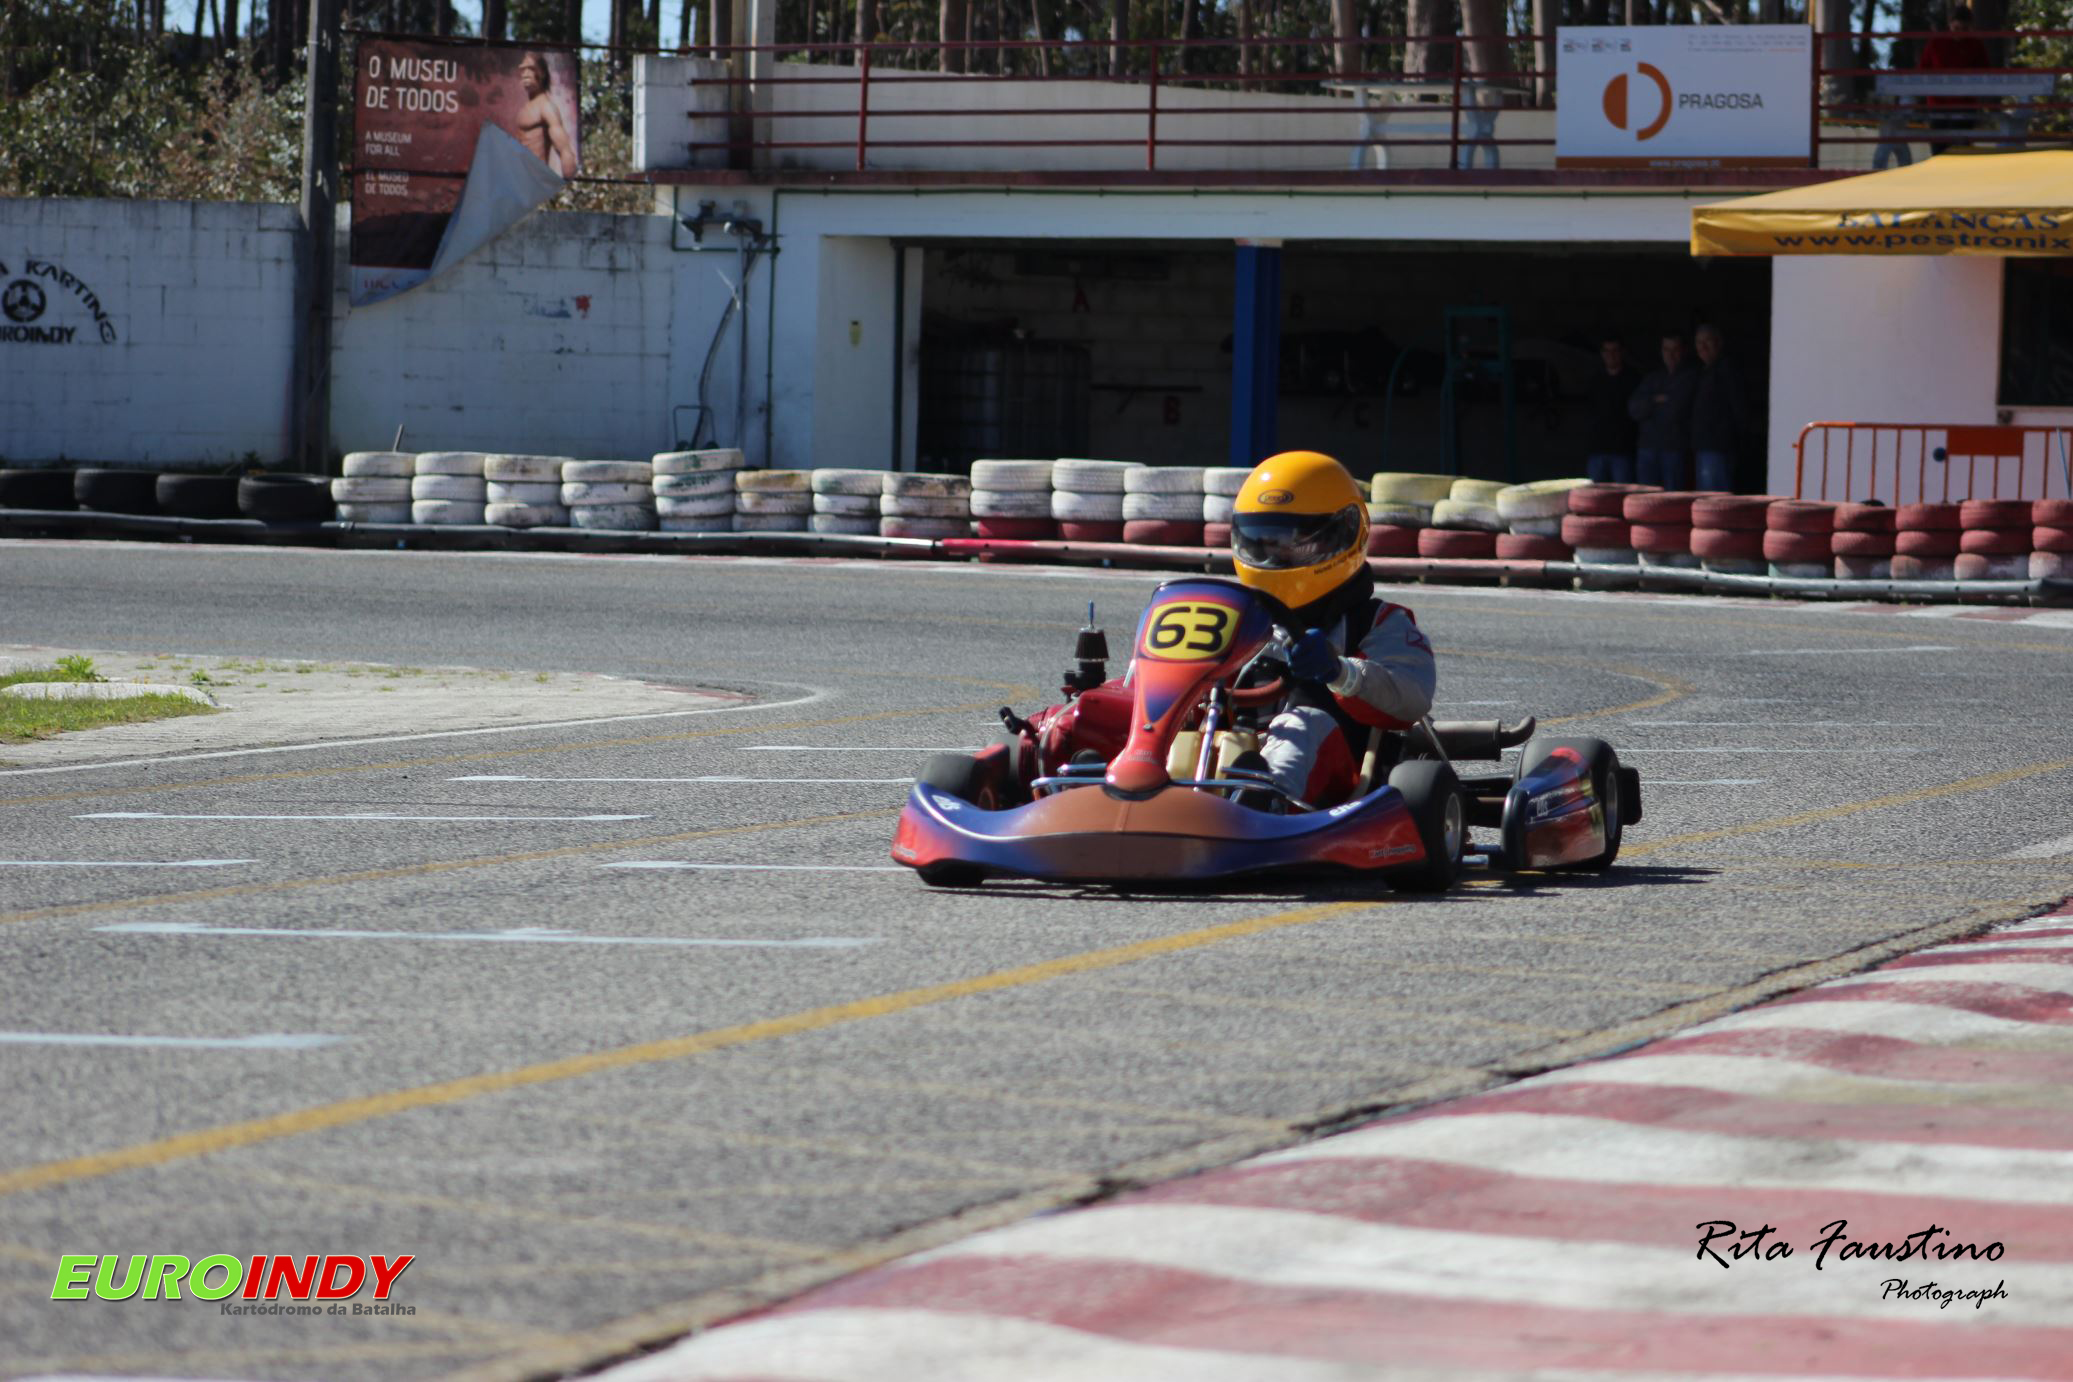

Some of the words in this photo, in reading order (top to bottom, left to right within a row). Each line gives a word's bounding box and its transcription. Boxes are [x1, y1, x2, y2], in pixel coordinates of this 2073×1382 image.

[369, 55, 381, 78] O
[390, 57, 458, 83] MUSEU
[365, 86, 389, 109] DE
[395, 87, 460, 113] TODOS
[1678, 93, 1764, 110] PRAGOSA
[365, 131, 372, 142] A
[373, 131, 412, 145] MUSEUM
[365, 143, 383, 155] FOR
[384, 144, 401, 156] ALL
[365, 183, 377, 195] DE
[379, 183, 408, 197] TODOS
[0, 325, 76, 344] ROINDY
[1151, 606, 1228, 652] 63
